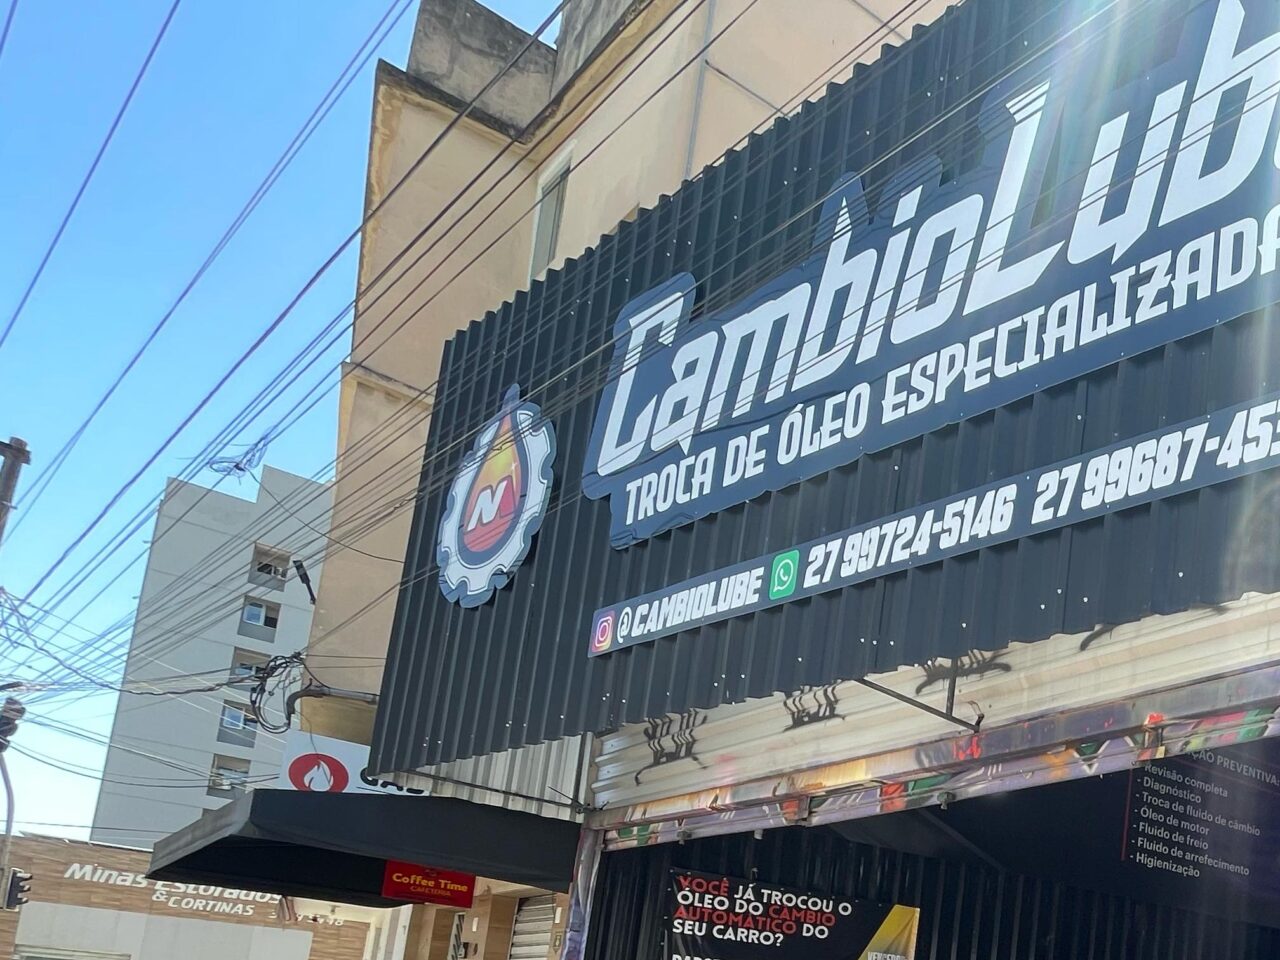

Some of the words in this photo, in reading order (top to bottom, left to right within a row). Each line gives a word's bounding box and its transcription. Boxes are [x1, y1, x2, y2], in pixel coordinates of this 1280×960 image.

[625, 447, 717, 525] TROCA
[723, 424, 770, 487] DE
[777, 382, 871, 465] ÓLEO
[616, 567, 765, 643] @CAMBIOLUBE
[803, 544, 841, 588] 27
[840, 484, 1017, 578] 99724-5146
[1031, 463, 1081, 524] 27
[1144, 764, 1183, 783] Revisão
[1185, 774, 1228, 797] completa
[1216, 755, 1280, 787] PREVENTIVA:
[1143, 777, 1201, 804] Diagnóstico
[1140, 805, 1164, 822] Óleo
[1166, 814, 1179, 827] de
[1181, 818, 1210, 836] motor
[1142, 791, 1170, 809] Troca
[1172, 800, 1184, 813] de
[1186, 803, 1213, 822] fluido
[1214, 813, 1227, 826] de
[1228, 818, 1260, 836] câmbio
[1139, 822, 1170, 839] Fluido
[1172, 830, 1184, 843] de
[1186, 834, 1209, 850] freio
[1136, 852, 1200, 878] Higienização
[1137, 837, 1168, 855] Fluido
[1170, 845, 1183, 858] de
[1185, 850, 1250, 876] arrefecimento
[64, 862, 148, 889] Minas
[392, 872, 435, 888] Coffee
[438, 878, 468, 892] Time
[168, 896, 256, 916] CORTINAS
[677, 888, 729, 911] ÓLEO
[735, 900, 763, 916] DO
[678, 875, 728, 897] VOCÊ
[734, 883, 755, 900] JÁ
[761, 889, 833, 913] TROCOU
[838, 902, 852, 916] O
[673, 919, 706, 936] SEU
[712, 925, 784, 947] CARRO?
[802, 925, 829, 939] DO
